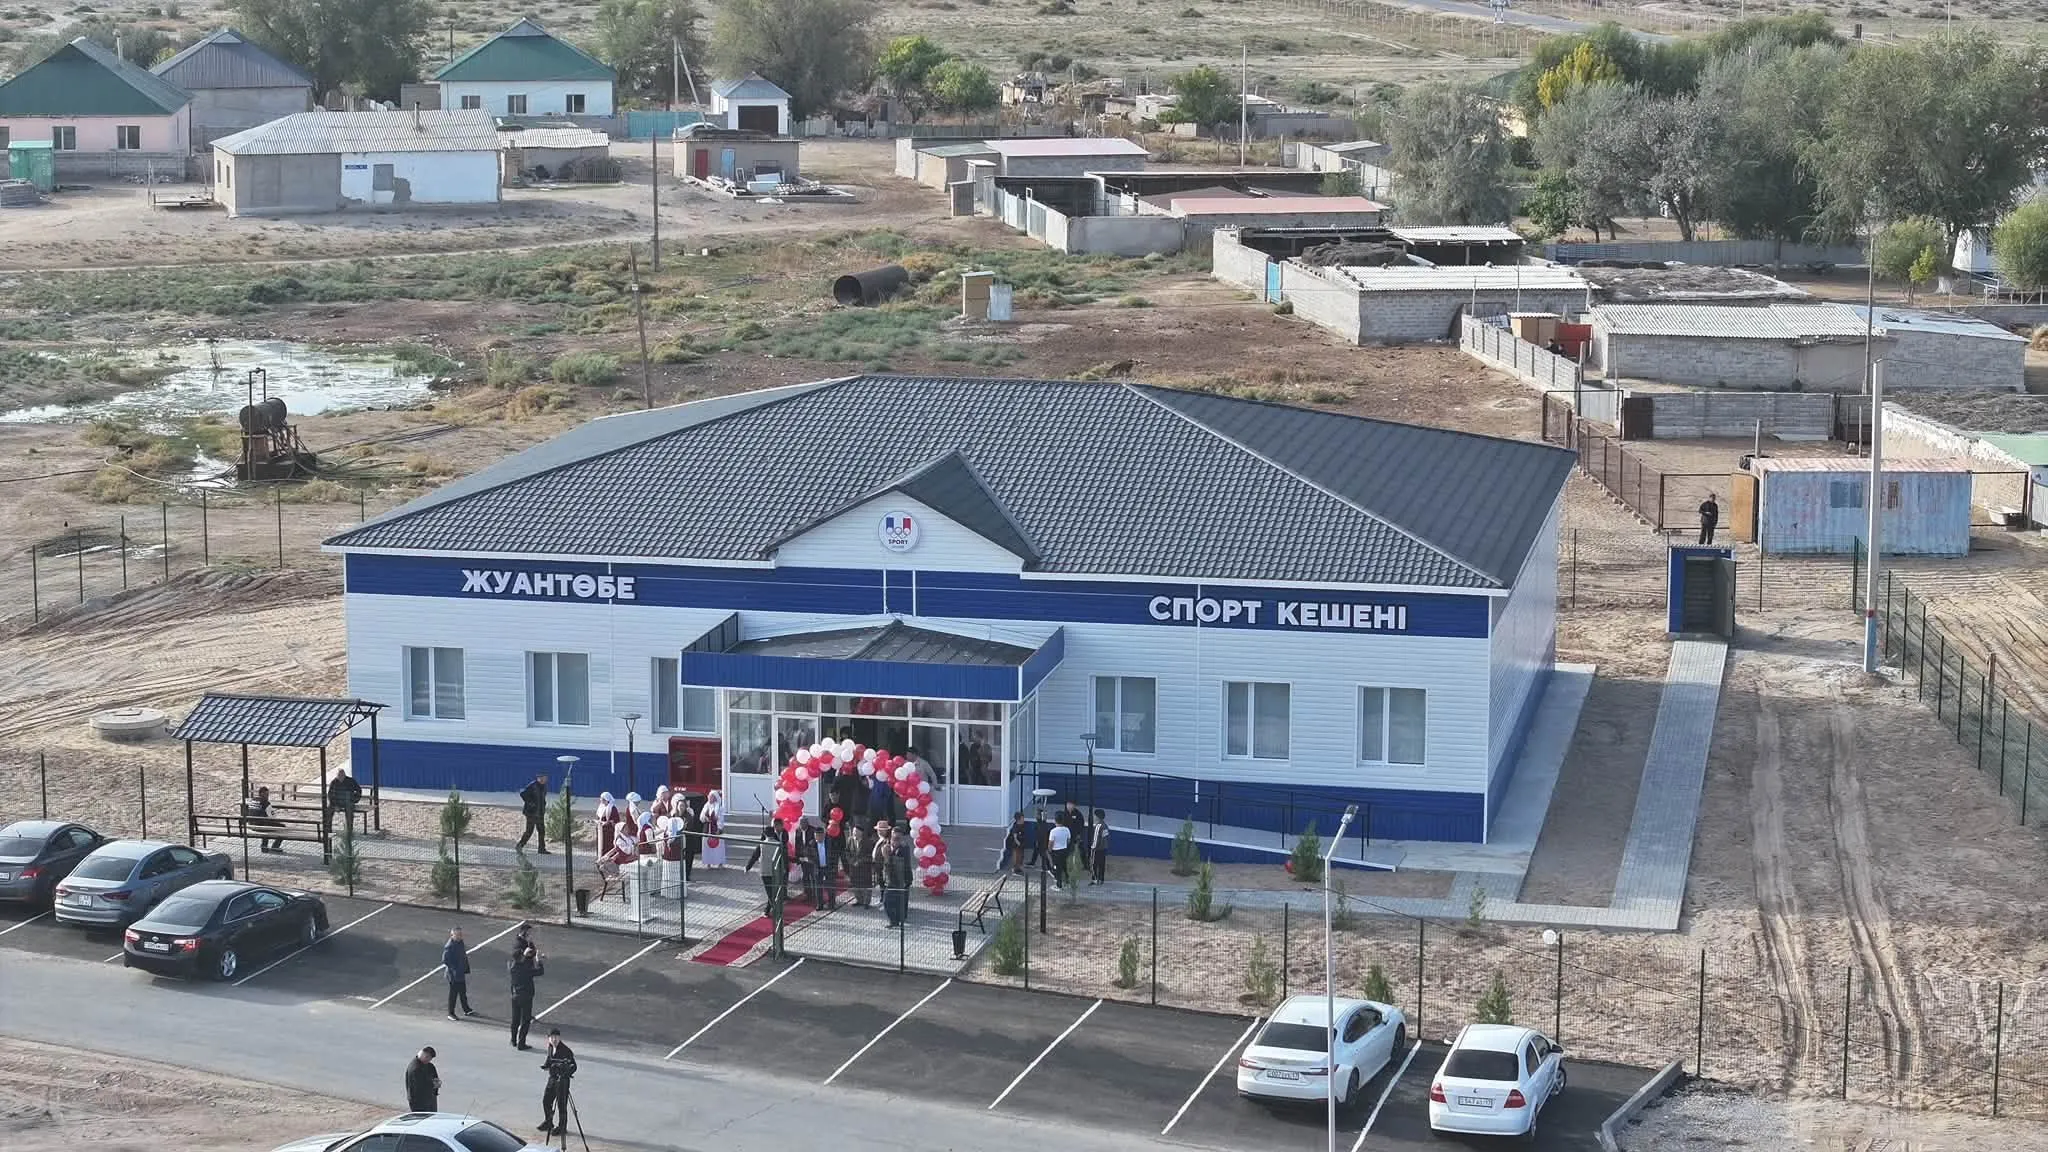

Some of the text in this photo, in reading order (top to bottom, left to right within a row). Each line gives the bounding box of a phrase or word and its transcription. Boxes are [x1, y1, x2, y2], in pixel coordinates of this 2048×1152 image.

[461, 569, 636, 599] ЖУАНТӨБЕ
[1148, 595, 1407, 630] СПОРТ КЕШЕНІ
